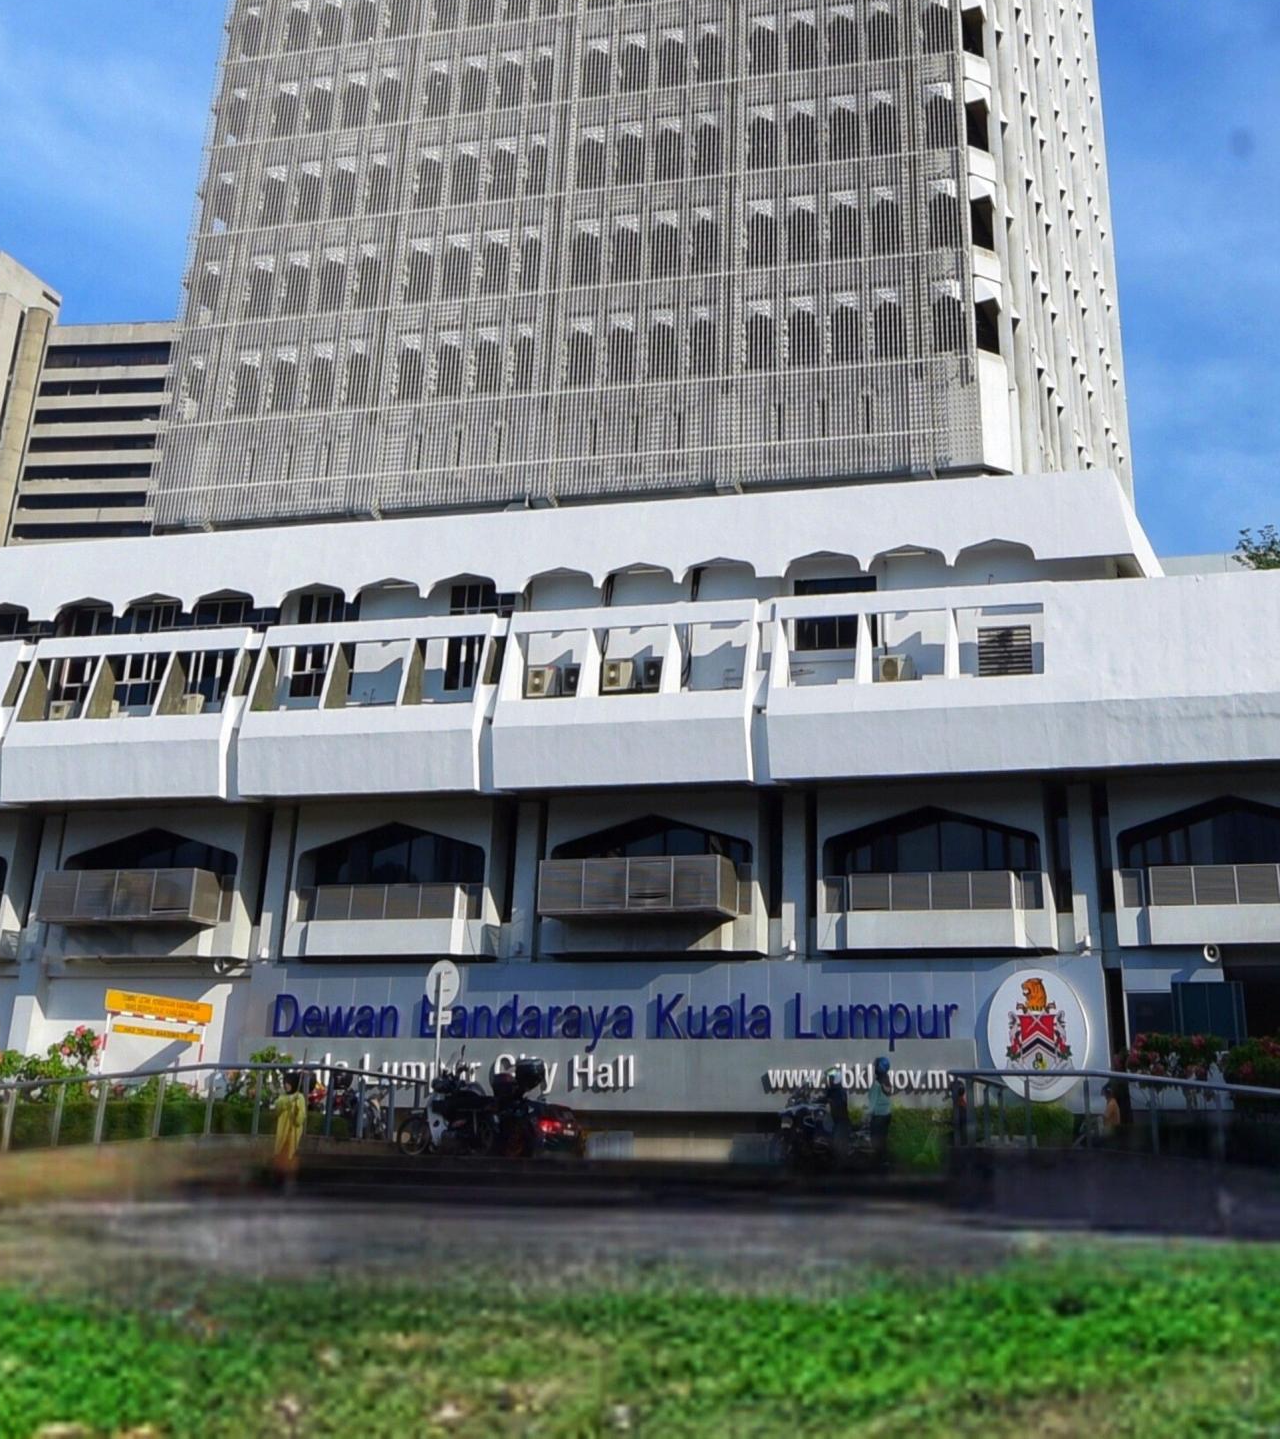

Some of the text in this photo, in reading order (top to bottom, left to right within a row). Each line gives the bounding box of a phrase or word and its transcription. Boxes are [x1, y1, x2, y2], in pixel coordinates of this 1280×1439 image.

[272, 993, 400, 1039] Dewan
[655, 992, 772, 1040] Kuala
[794, 992, 959, 1052] Lumpur
[494, 1053, 558, 1094] Cy
[573, 1054, 635, 1088] Hall
